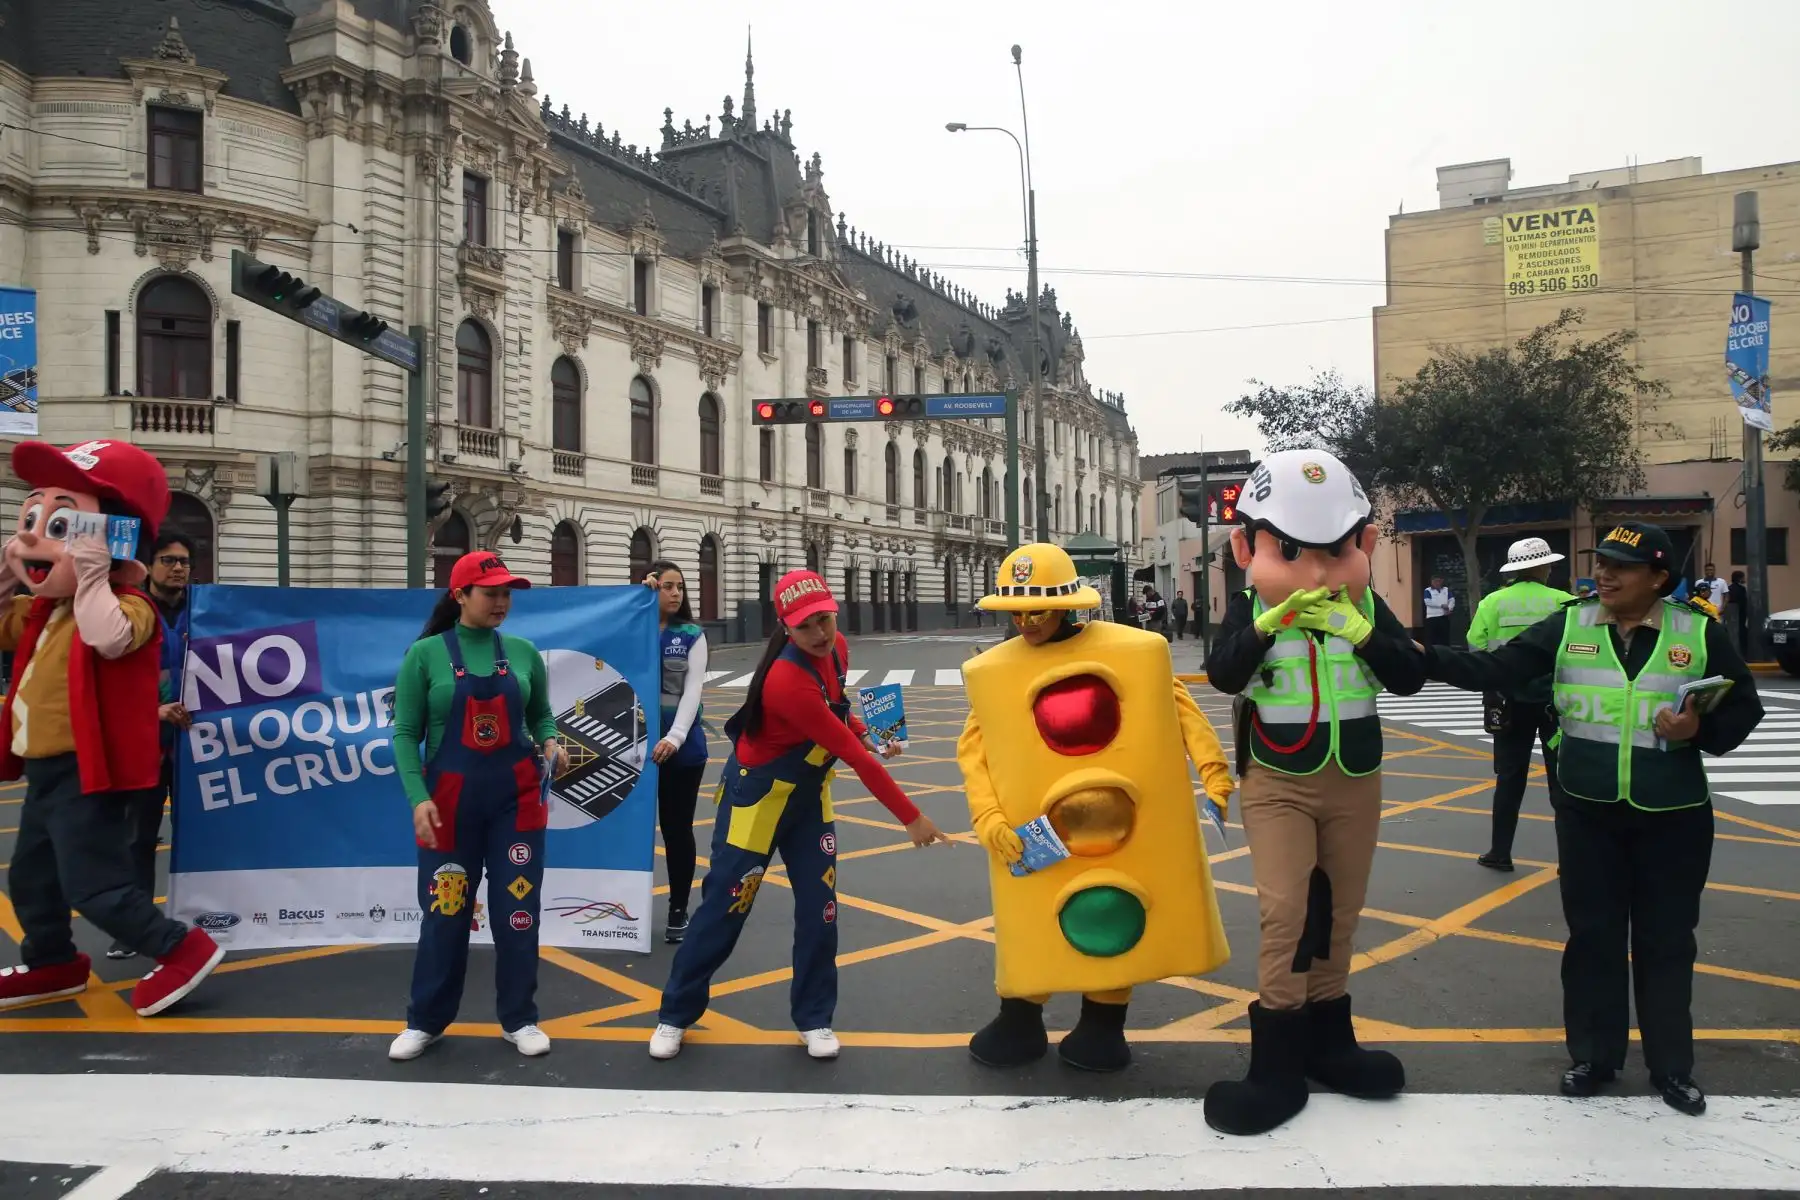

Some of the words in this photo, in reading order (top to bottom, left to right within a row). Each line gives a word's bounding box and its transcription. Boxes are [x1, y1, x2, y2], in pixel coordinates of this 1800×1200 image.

[1506, 208, 1595, 233] VENTA
[1506, 232, 1547, 243] ULTIMAS
[1550, 226, 1596, 237] OFICINAS
[1521, 242, 1537, 250] MINI
[1540, 235, 1597, 249] DEPARTAMENTOS
[1518, 247, 1581, 260] REMODELADOS
[1526, 256, 1582, 269] ASCENSORES
[1526, 267, 1570, 278] CARABAYA
[1509, 280, 1535, 295] 983
[1540, 277, 1567, 292] 506
[1572, 273, 1598, 289] 530
[0, 327, 23, 340] CE
[1729, 340, 1740, 351] EL
[1223, 489, 1236, 500] 32
[779, 578, 827, 609] POLICIA
[182, 634, 307, 712] NO
[861, 692, 874, 704] NO
[864, 692, 897, 711] BLOQUEES
[866, 711, 874, 719] EL
[873, 701, 896, 715] CRUCE
[188, 686, 396, 764] BLOQUE
[198, 768, 257, 811] EL
[265, 739, 396, 795] CRUC
[1028, 819, 1042, 834] NO
[516, 847, 525, 860] E
[203, 915, 232, 926] Ford
[512, 916, 531, 926] PARE
[581, 929, 638, 940] TRANSITEMOS
